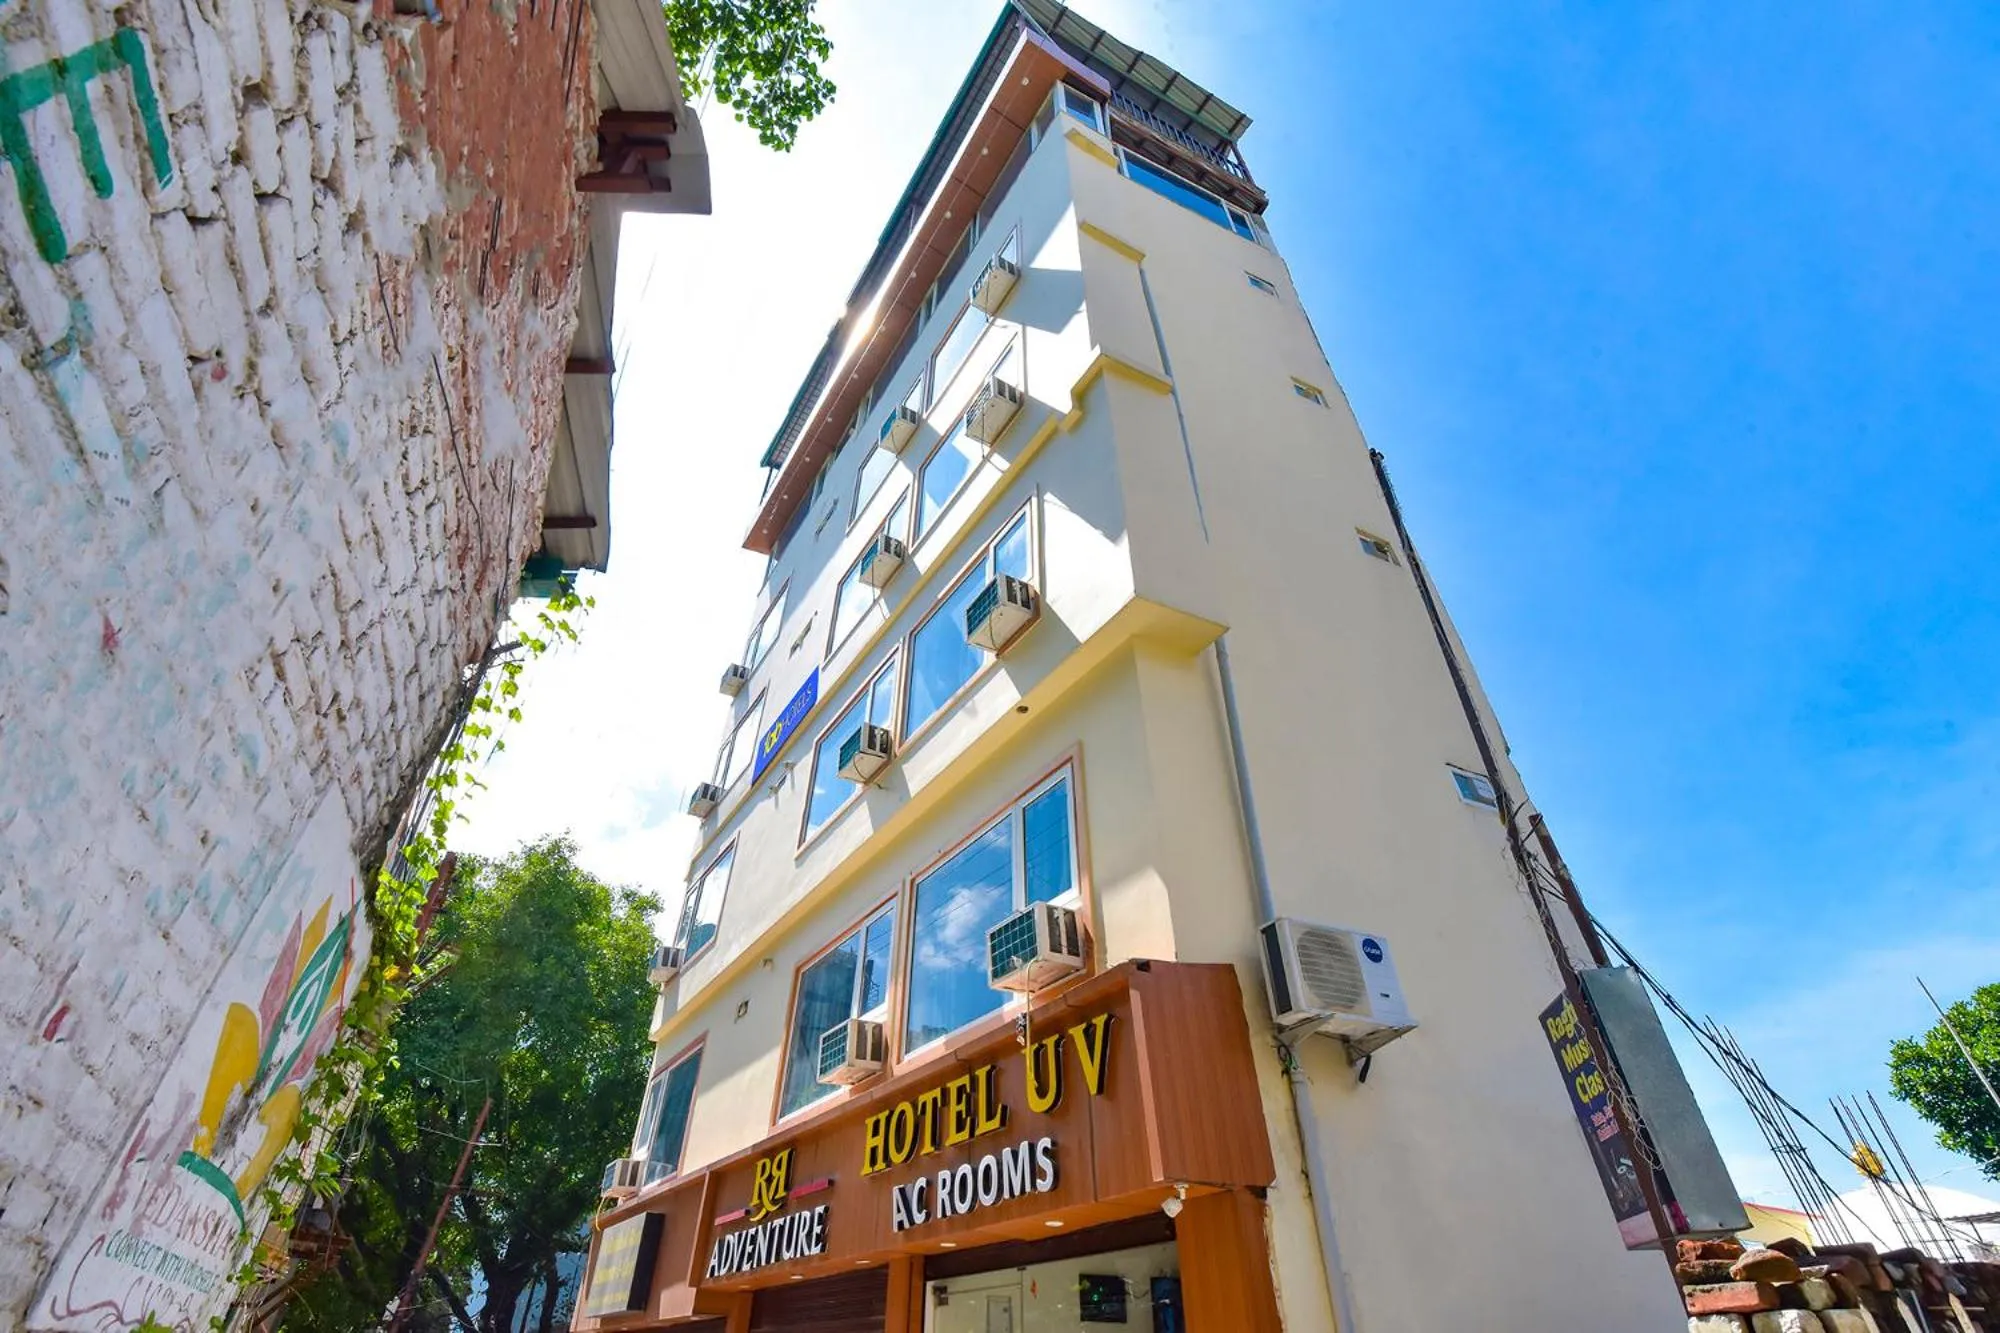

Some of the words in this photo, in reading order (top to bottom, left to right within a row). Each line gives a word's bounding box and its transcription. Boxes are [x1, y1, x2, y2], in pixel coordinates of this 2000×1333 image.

[860, 1064, 1005, 1176] HOTEL
[892, 1176, 929, 1233] AC
[936, 1137, 1056, 1219] ROOMS
[105, 1229, 163, 1273] CONNECT
[706, 1204, 828, 1279] ADVENTURE
